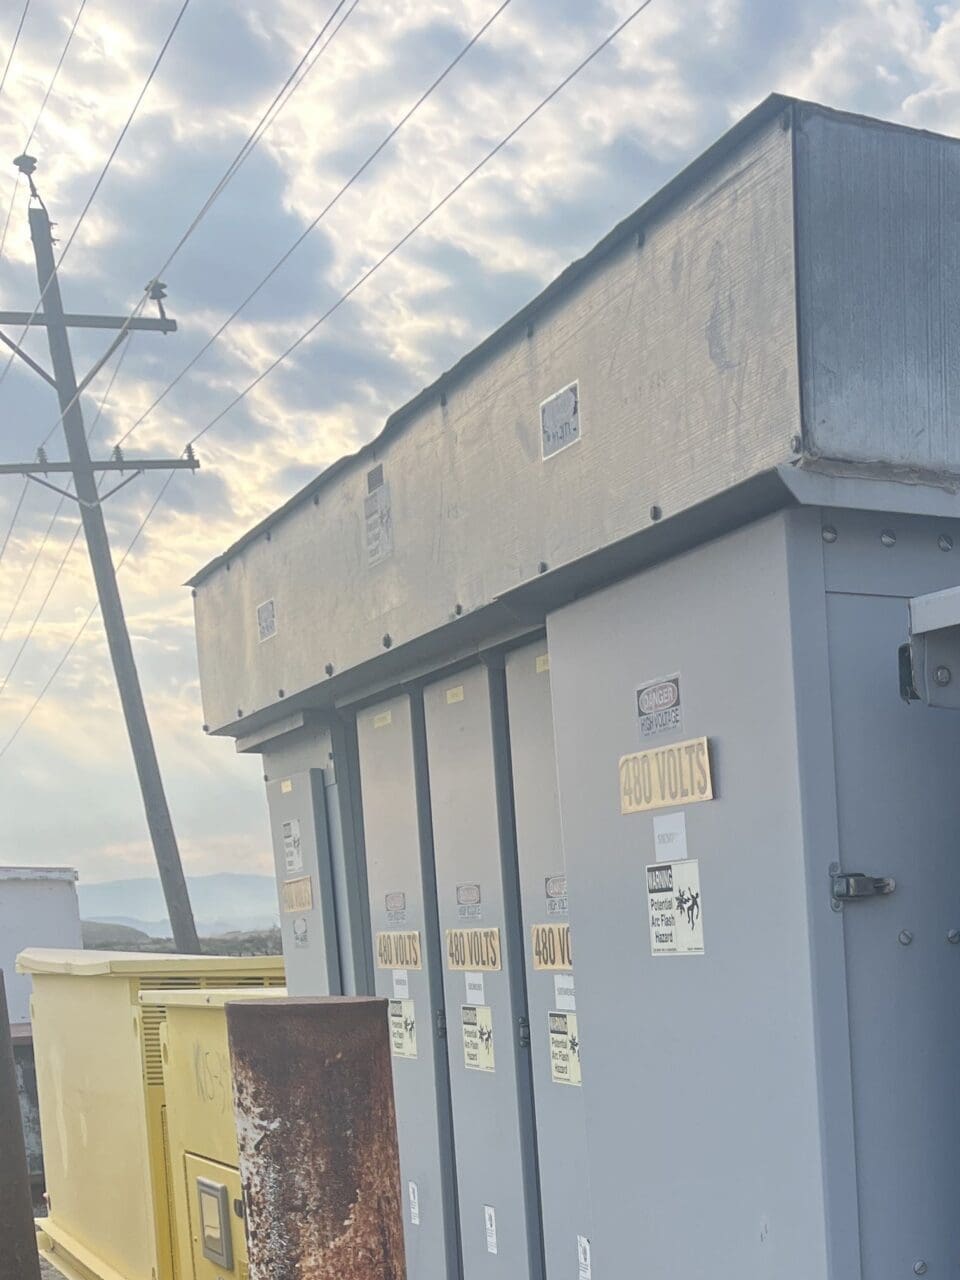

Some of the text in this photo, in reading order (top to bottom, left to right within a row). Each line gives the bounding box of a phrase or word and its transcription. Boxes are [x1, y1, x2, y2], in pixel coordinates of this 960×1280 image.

[623, 742, 708, 806] 480 VOLTS
[651, 897, 673, 911] Potential
[651, 913, 675, 927] Arc Flash
[378, 934, 419, 966] 480 VOLTS
[449, 930, 498, 967] 480 VOLTS
[535, 927, 556, 965] 480
[655, 931, 673, 943] Hazard
